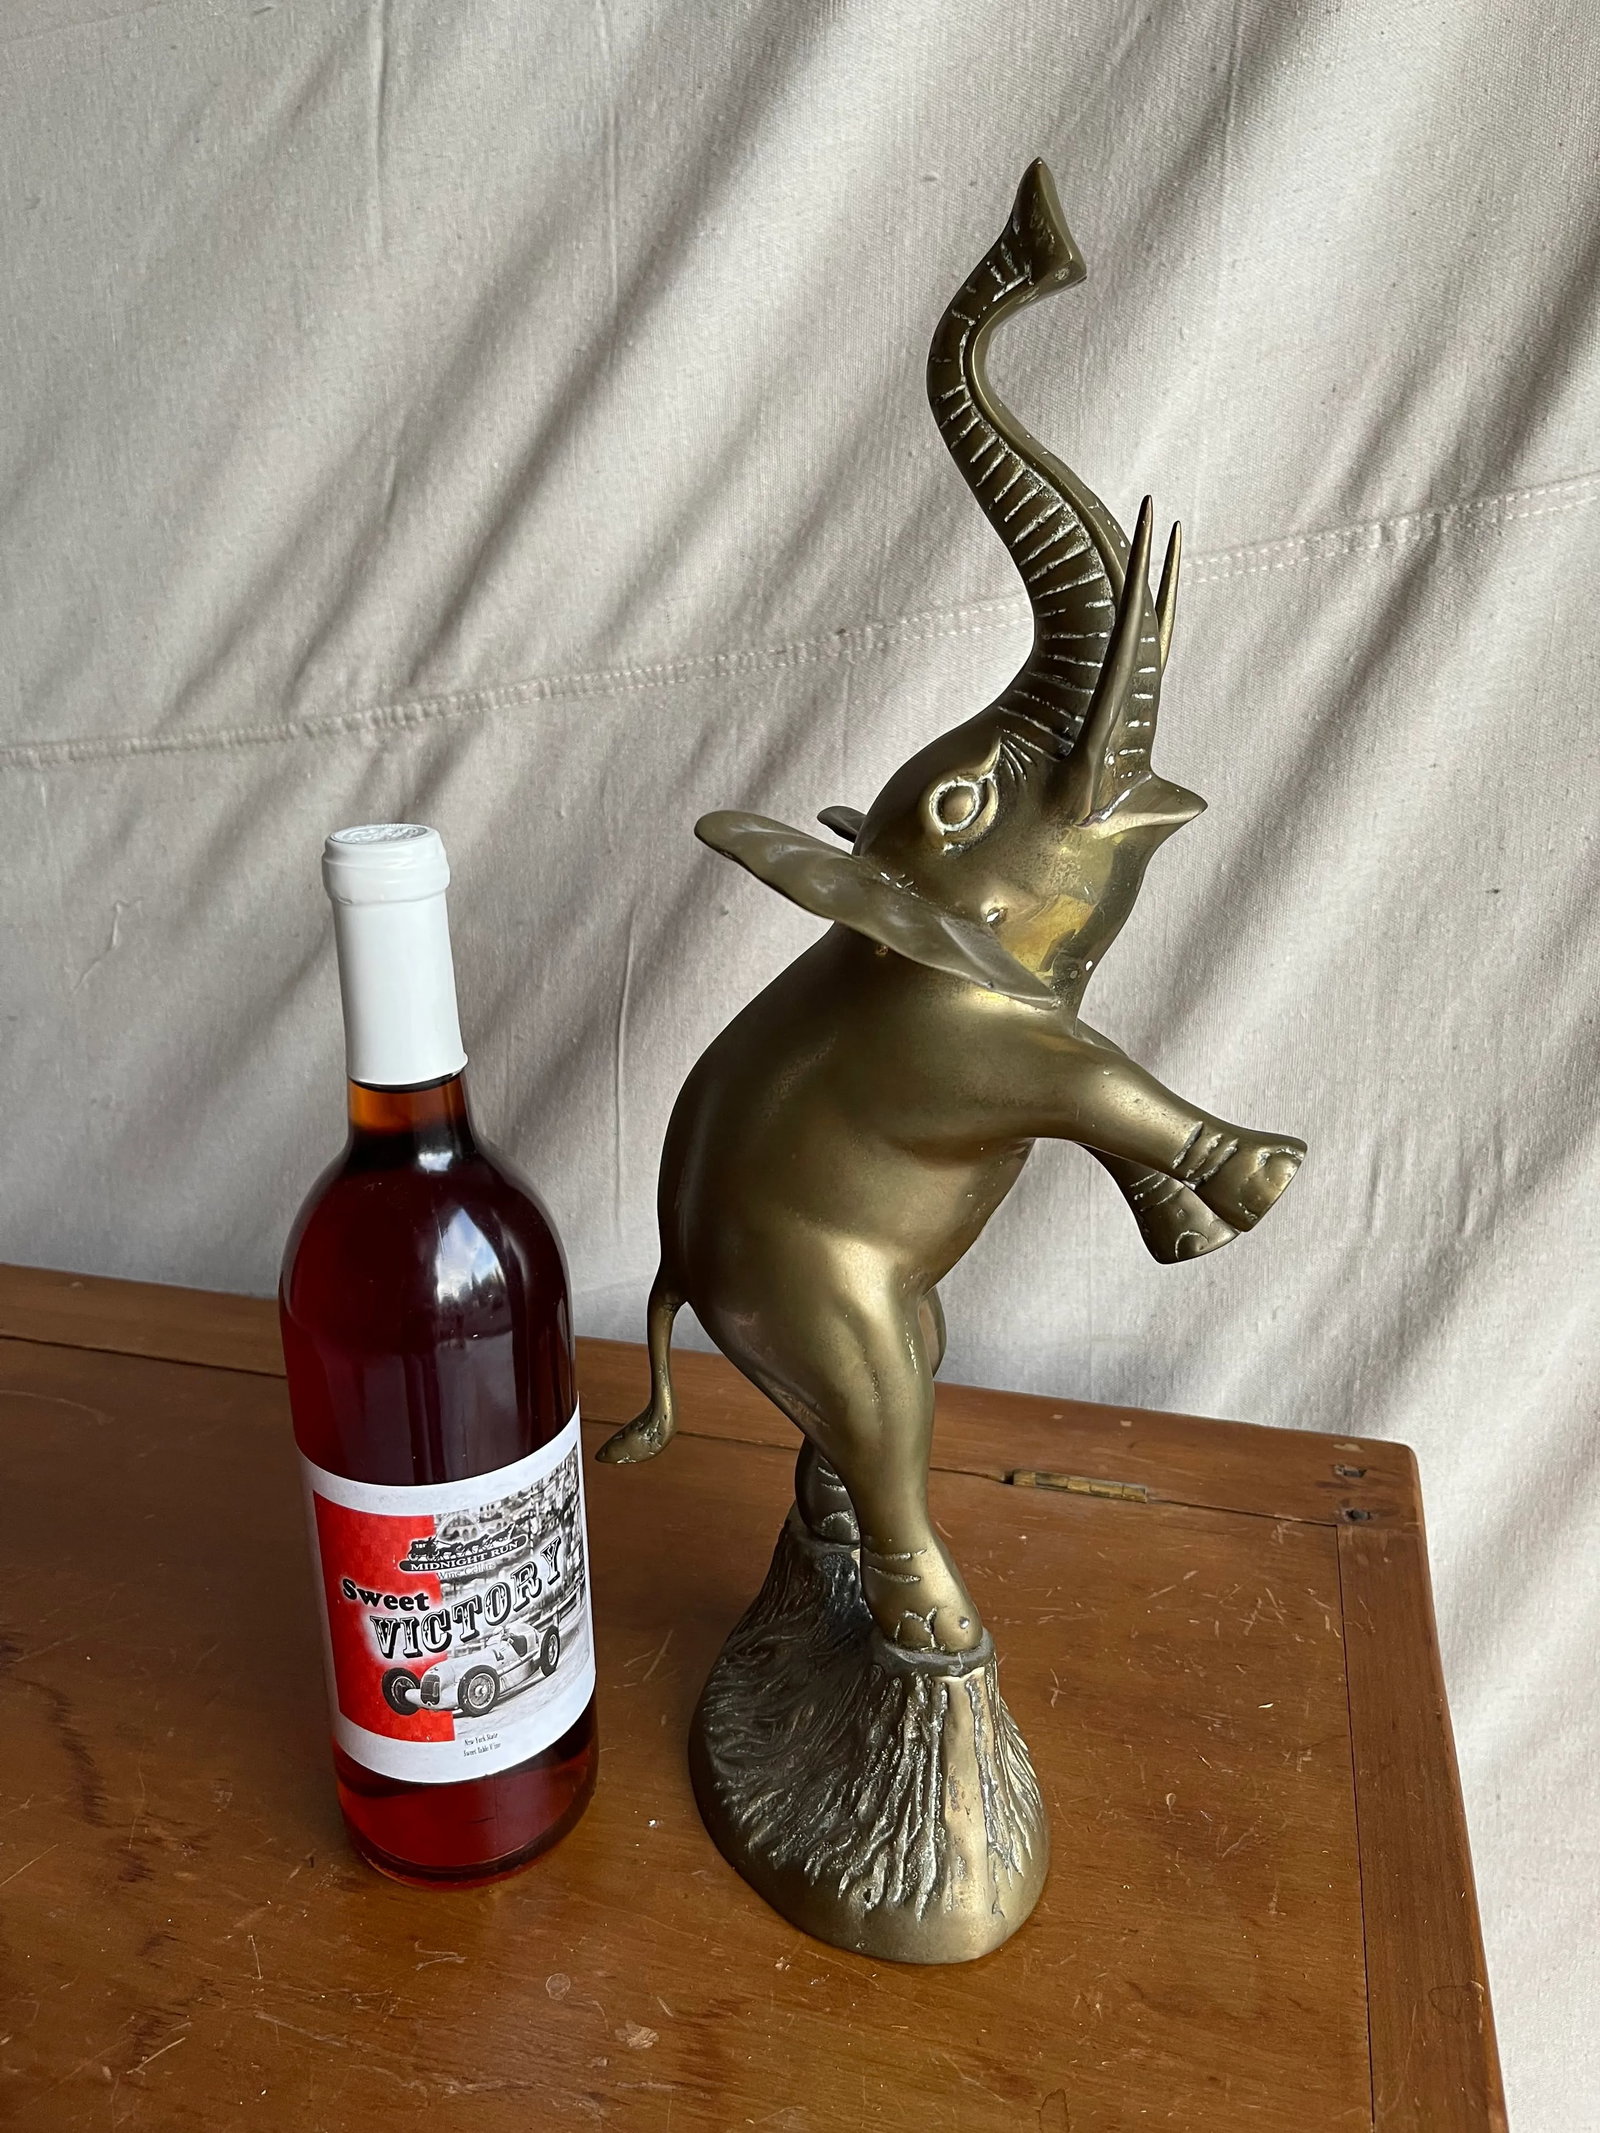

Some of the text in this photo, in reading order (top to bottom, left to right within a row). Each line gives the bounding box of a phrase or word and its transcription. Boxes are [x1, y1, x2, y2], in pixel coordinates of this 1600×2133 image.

[411, 1543, 519, 1571] MIDNIGHT RUN
[437, 1562, 496, 1581] Wine Cellars
[342, 1578, 430, 1612] Sweet
[370, 1536, 562, 1659] VICTORY
[475, 1735, 487, 1744] York
